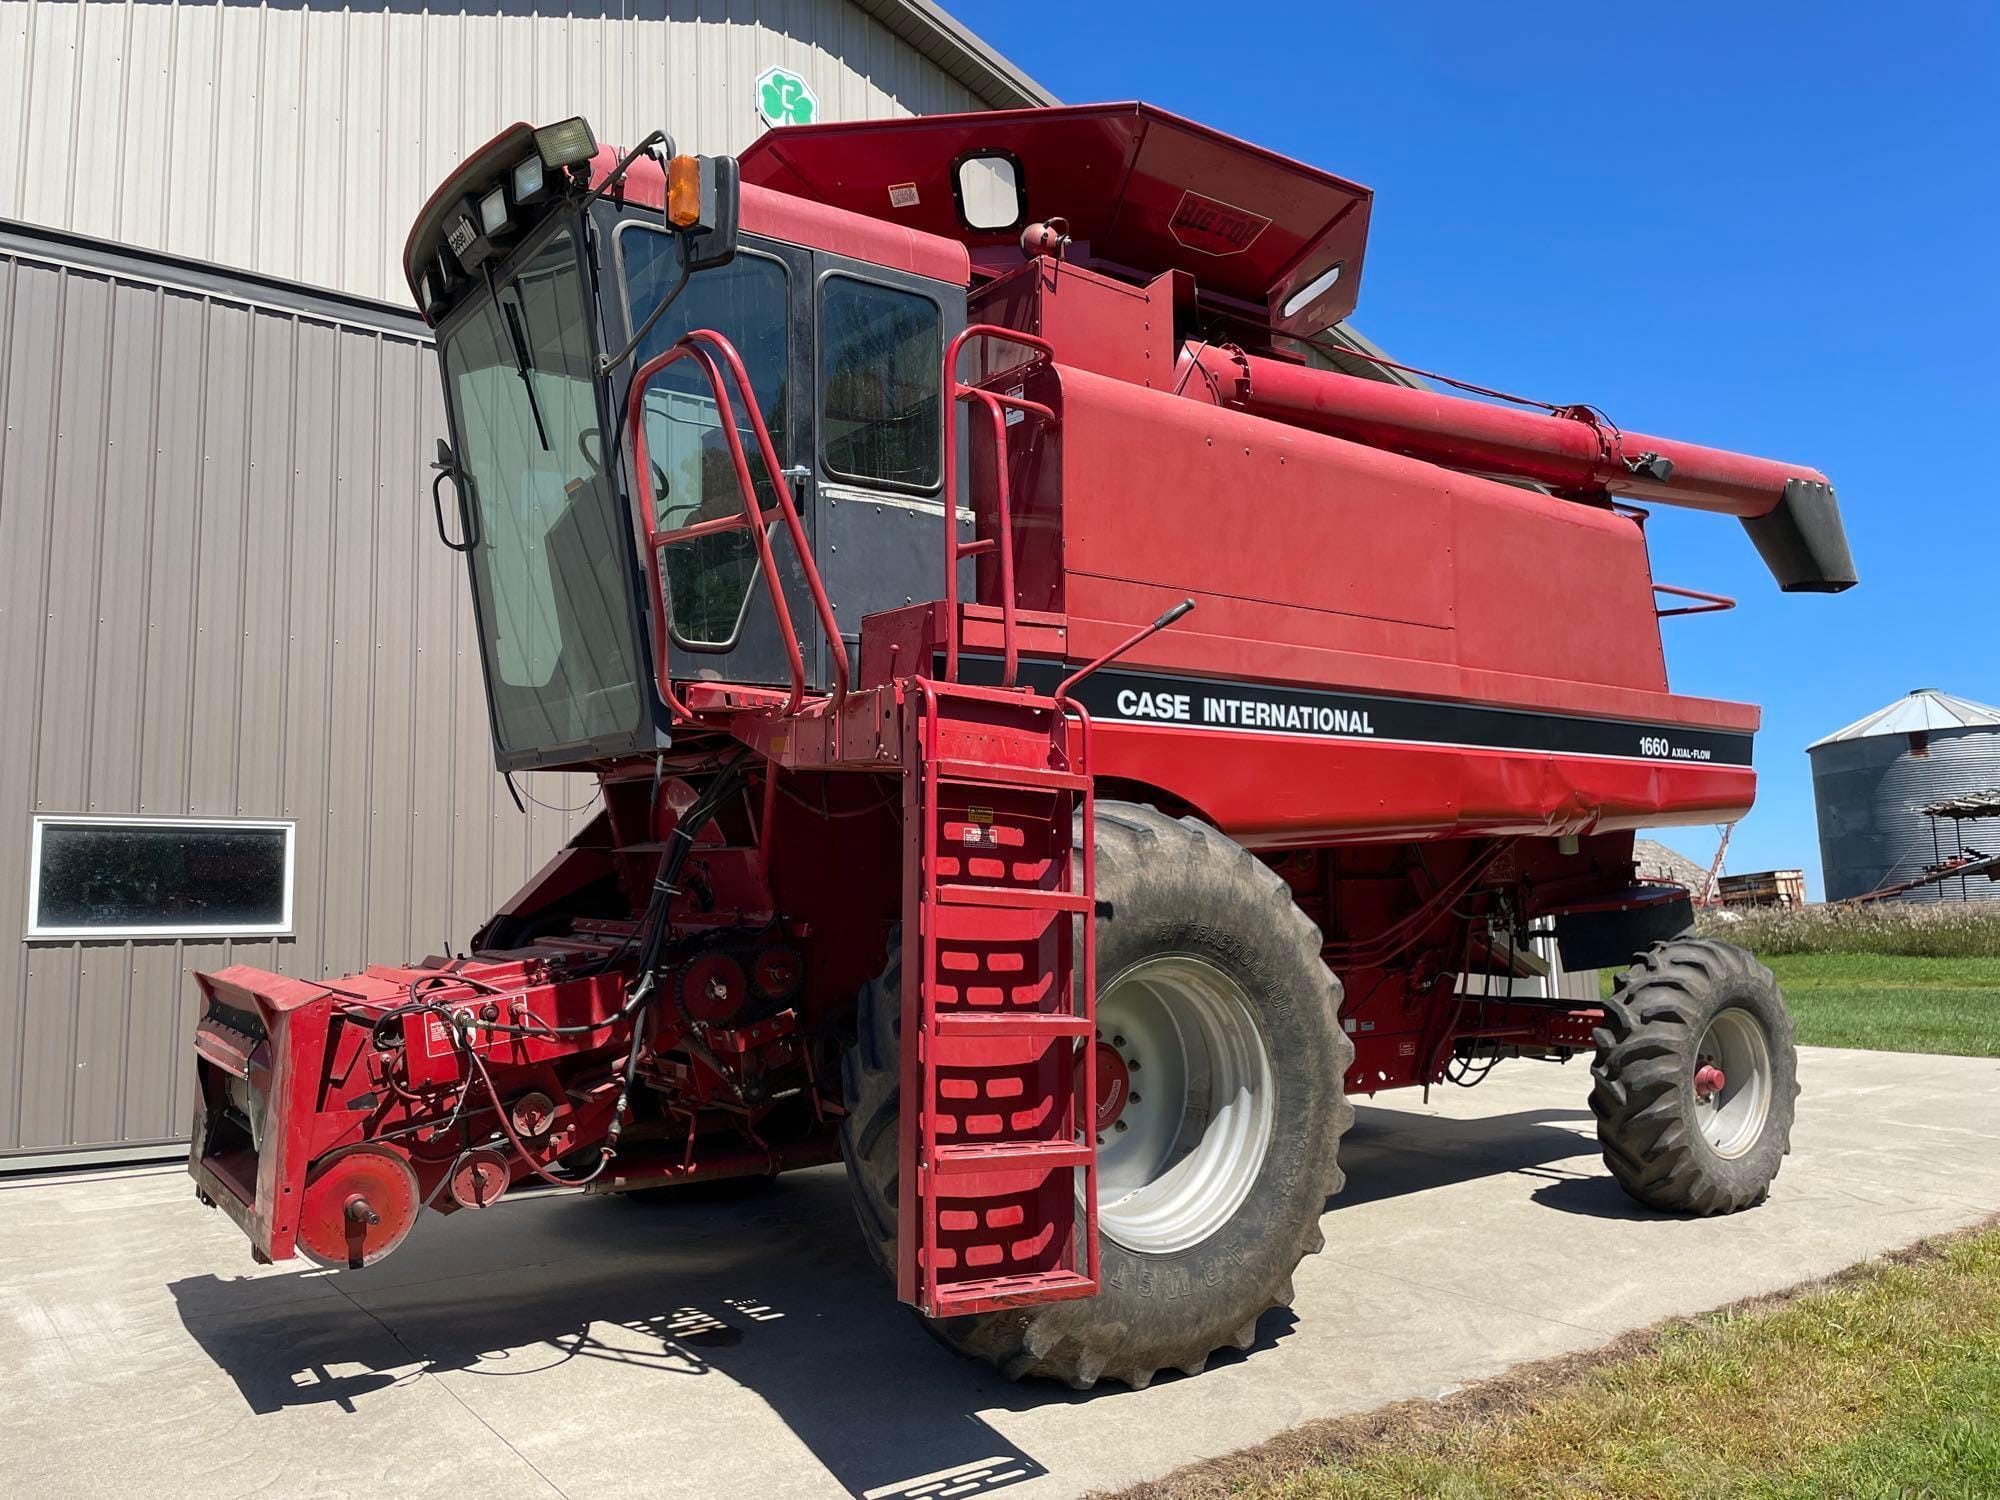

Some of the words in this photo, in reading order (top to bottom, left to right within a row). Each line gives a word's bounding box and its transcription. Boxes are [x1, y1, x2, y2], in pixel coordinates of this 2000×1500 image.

[1174, 199, 1217, 232] BIG
[1215, 211, 1264, 246] TOP
[1116, 689, 1191, 721] CASE
[1202, 697, 1375, 735] INTERNATIONAL
[1639, 736, 1669, 757] 1660
[1671, 747, 1711, 760] AXIAL-FLOW
[1264, 979, 1293, 1020] LUG
